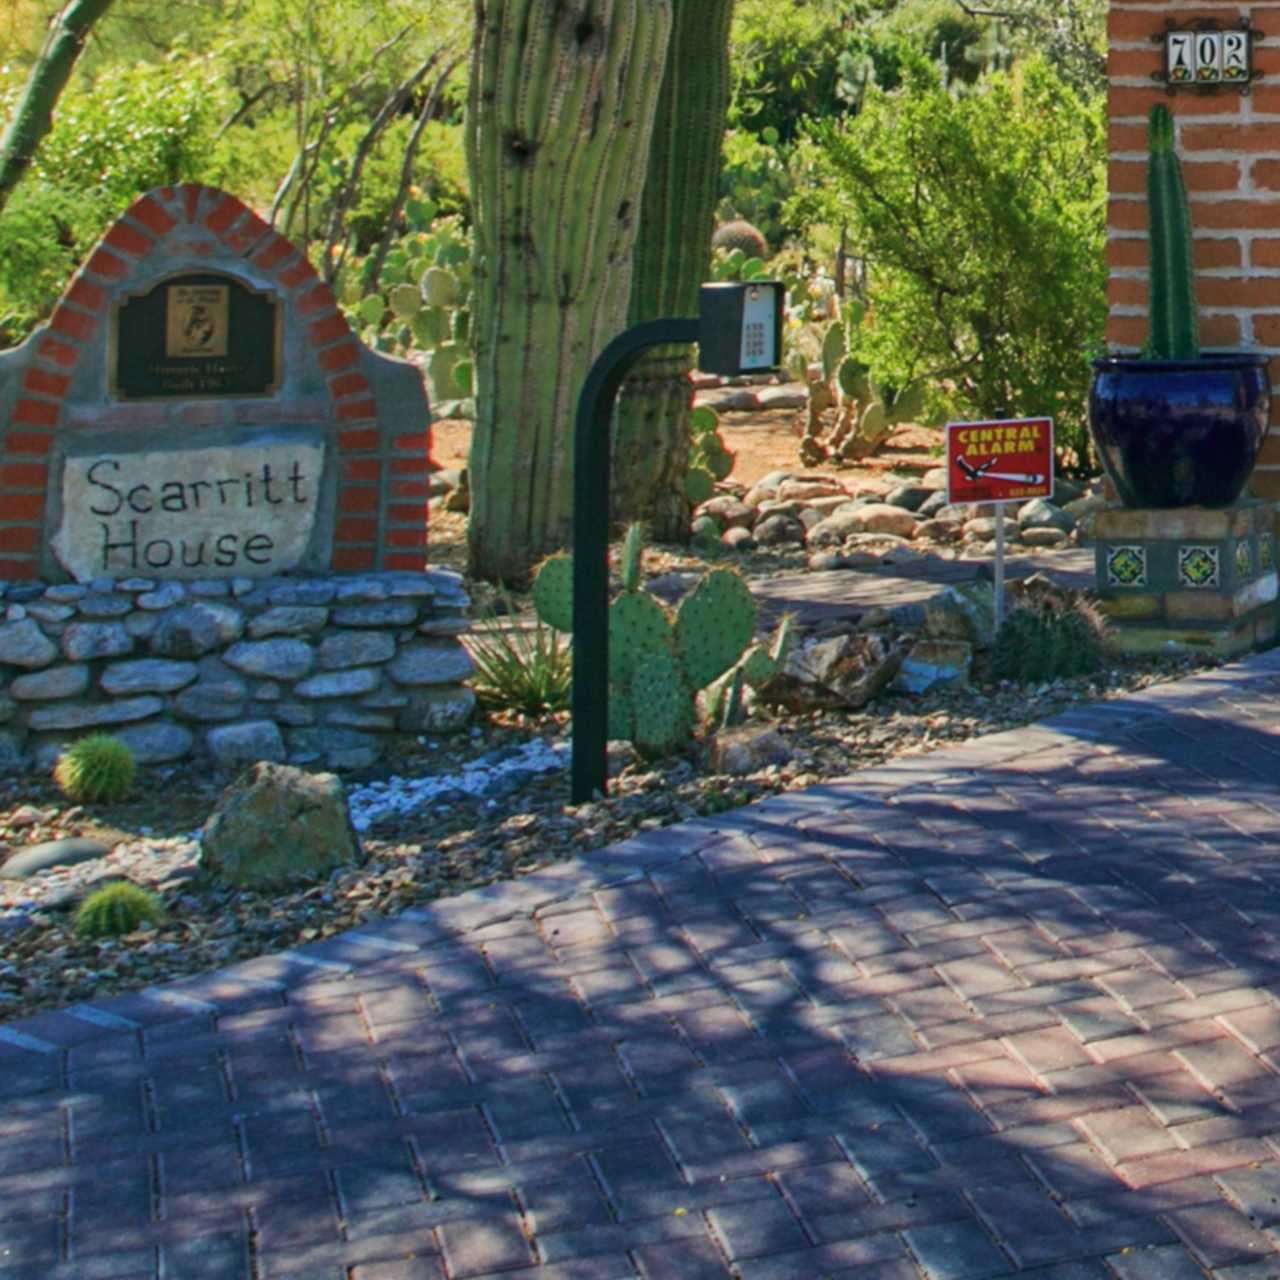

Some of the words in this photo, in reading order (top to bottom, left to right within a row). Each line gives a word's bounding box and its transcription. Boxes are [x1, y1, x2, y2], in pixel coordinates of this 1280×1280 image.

[1171, 34, 1243, 66] 702
[958, 425, 1041, 443] CENTRAL
[965, 439, 1036, 457] ALARM
[87, 459, 309, 517] Scarritt
[101, 521, 275, 571] House
